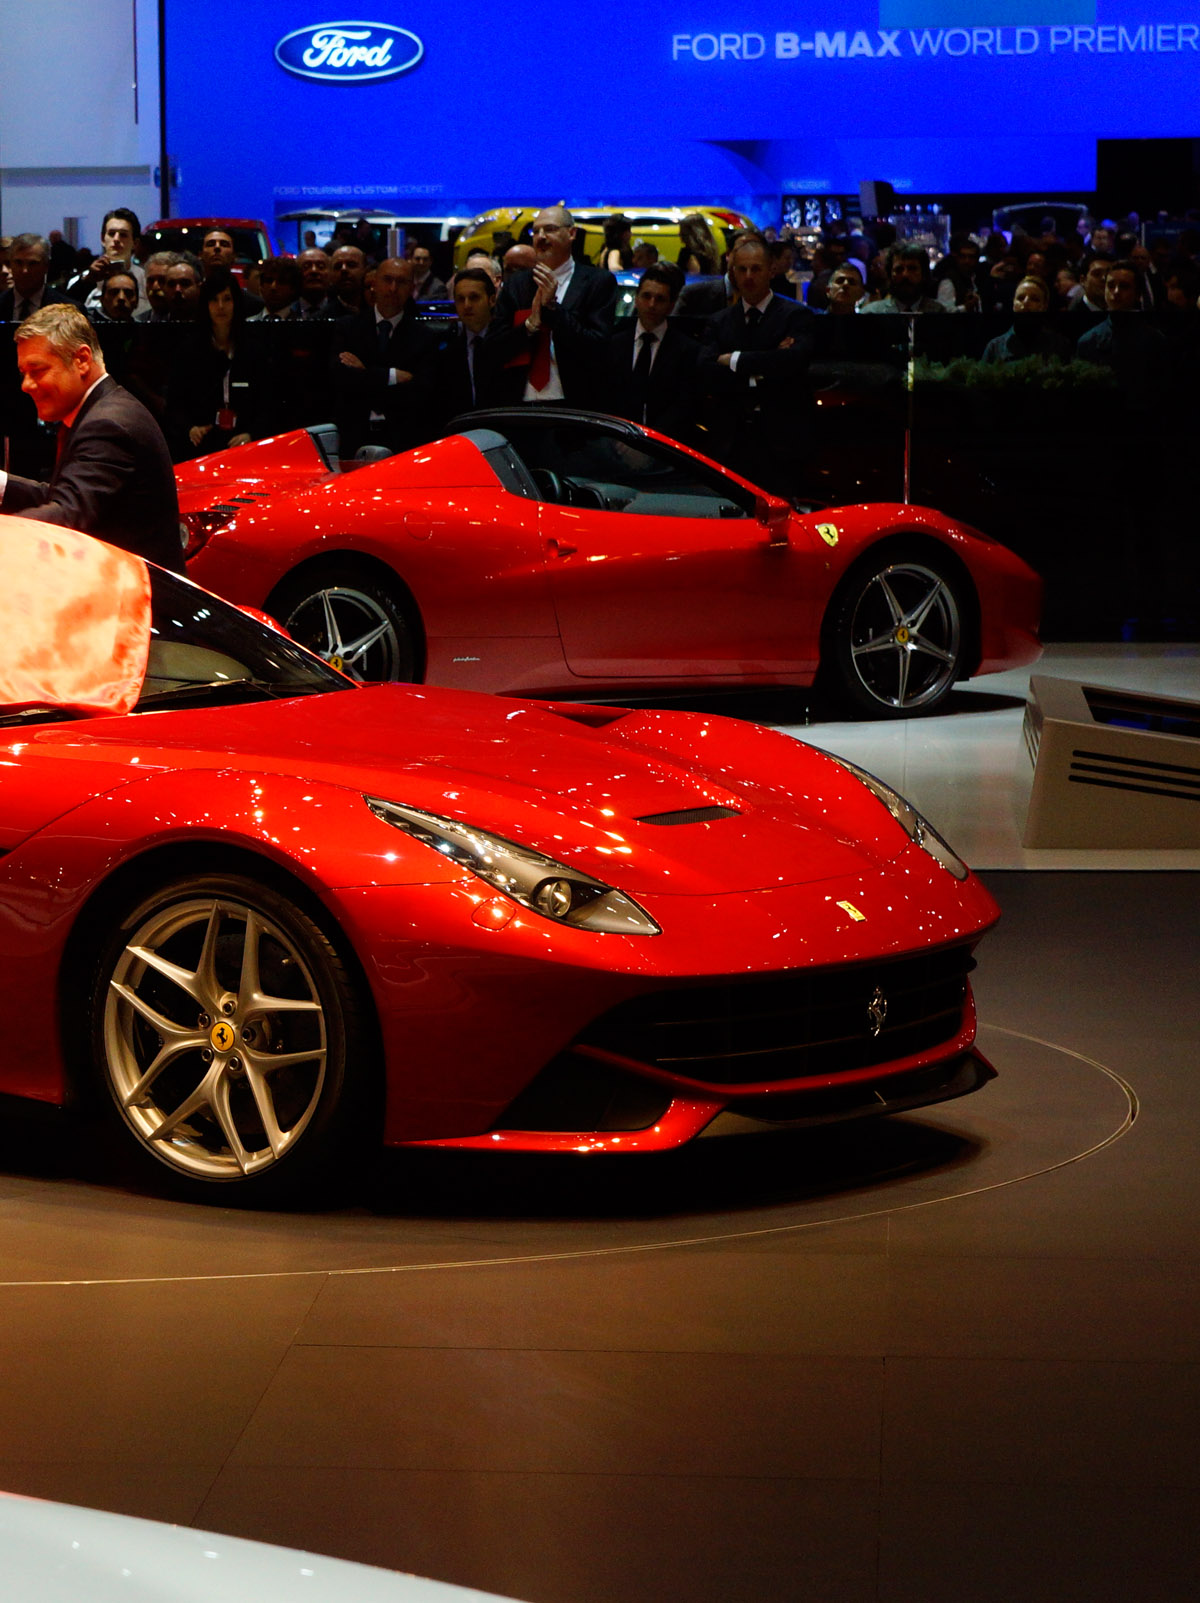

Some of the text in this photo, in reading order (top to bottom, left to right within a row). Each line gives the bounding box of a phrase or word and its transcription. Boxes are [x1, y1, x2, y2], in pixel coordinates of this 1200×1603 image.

[302, 29, 394, 68] Ford
[672, 32, 766, 61] FORD
[774, 30, 901, 59] B-MAX
[909, 27, 1040, 56] WORLD
[273, 183, 444, 196] FORD TOURNEO CUSTOM CONCEPT
